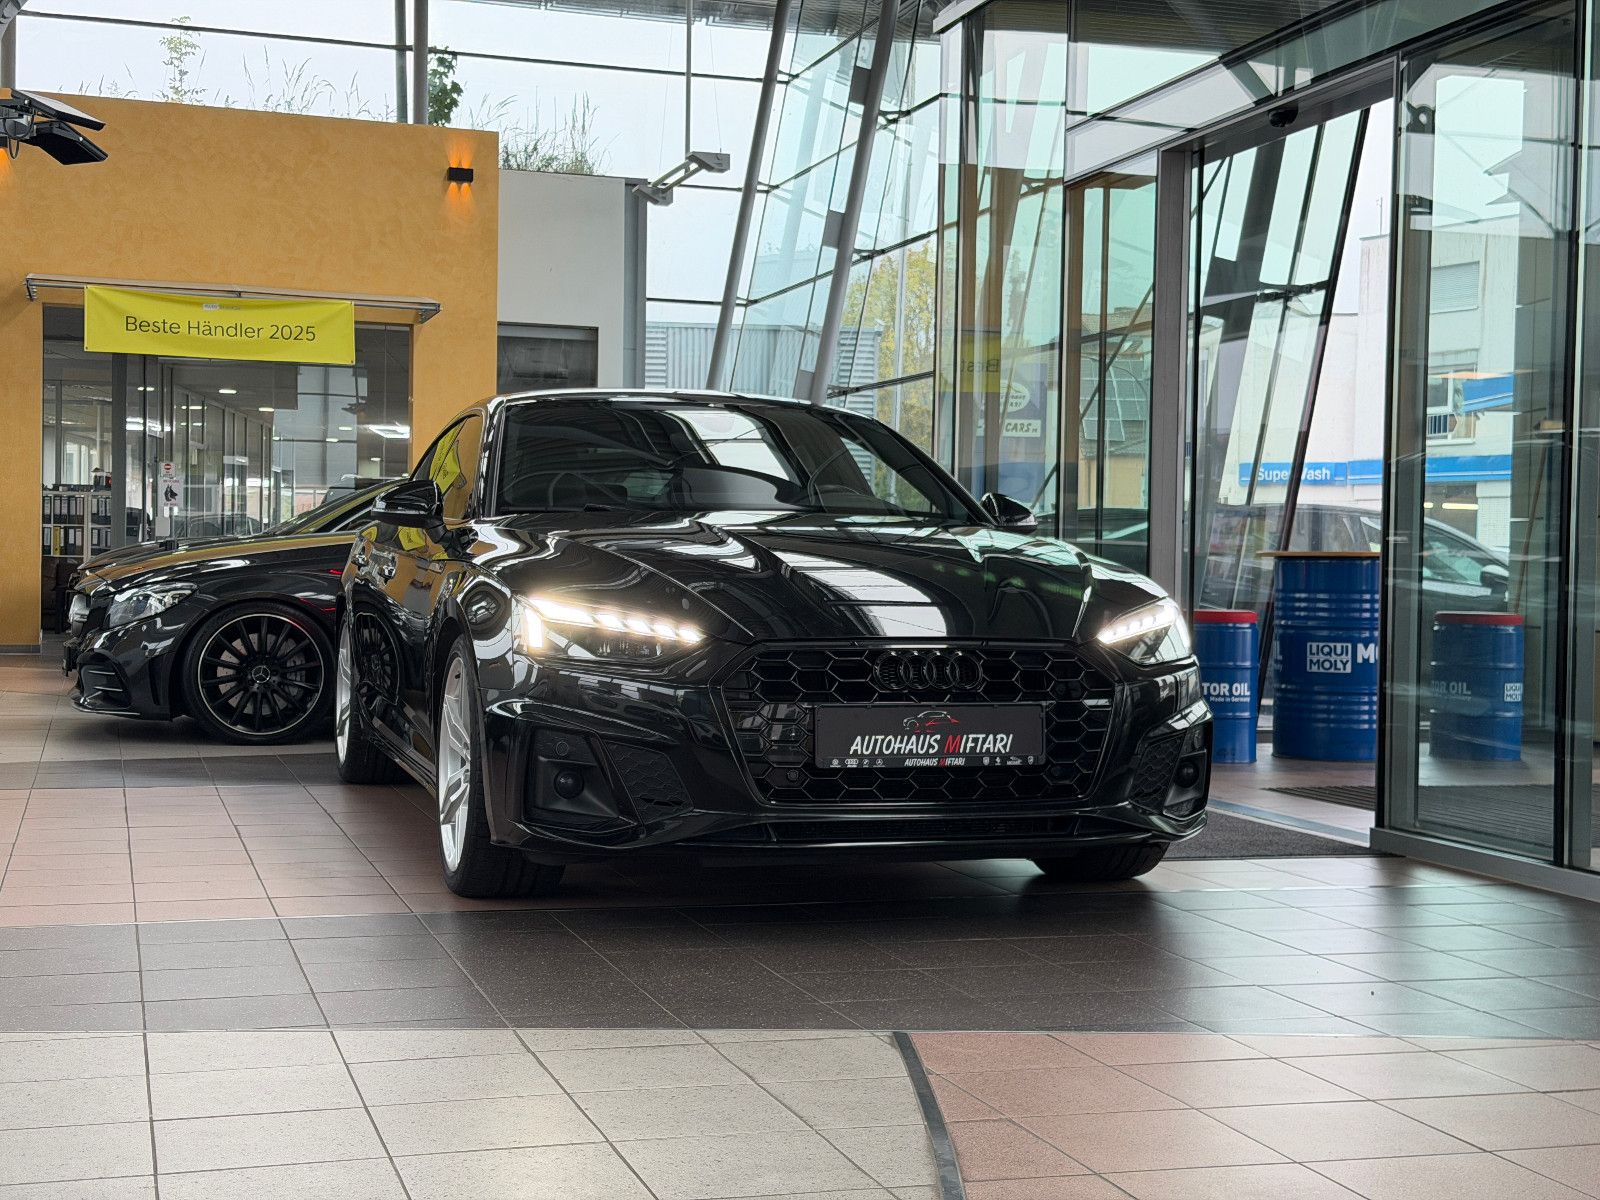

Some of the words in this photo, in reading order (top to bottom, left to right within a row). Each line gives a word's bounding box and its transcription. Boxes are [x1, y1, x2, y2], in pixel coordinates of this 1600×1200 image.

[125, 315, 181, 335] Beste
[187, 320, 264, 339] Händler
[269, 324, 316, 341] 2025
[1257, 468, 1288, 482] Supe
[1309, 644, 1350, 657] LIQUI
[1356, 643, 1379, 664] M
[1309, 658, 1350, 672] MOLY
[1201, 682, 1230, 696] TOR
[1232, 682, 1251, 696] OIL
[1449, 681, 1472, 695] OIL
[850, 734, 941, 755] AUTOHAUS
[944, 733, 1014, 754] MIFTARI
[904, 757, 939, 767] AUTOHAUS
[939, 757, 966, 767] MIFTARI
